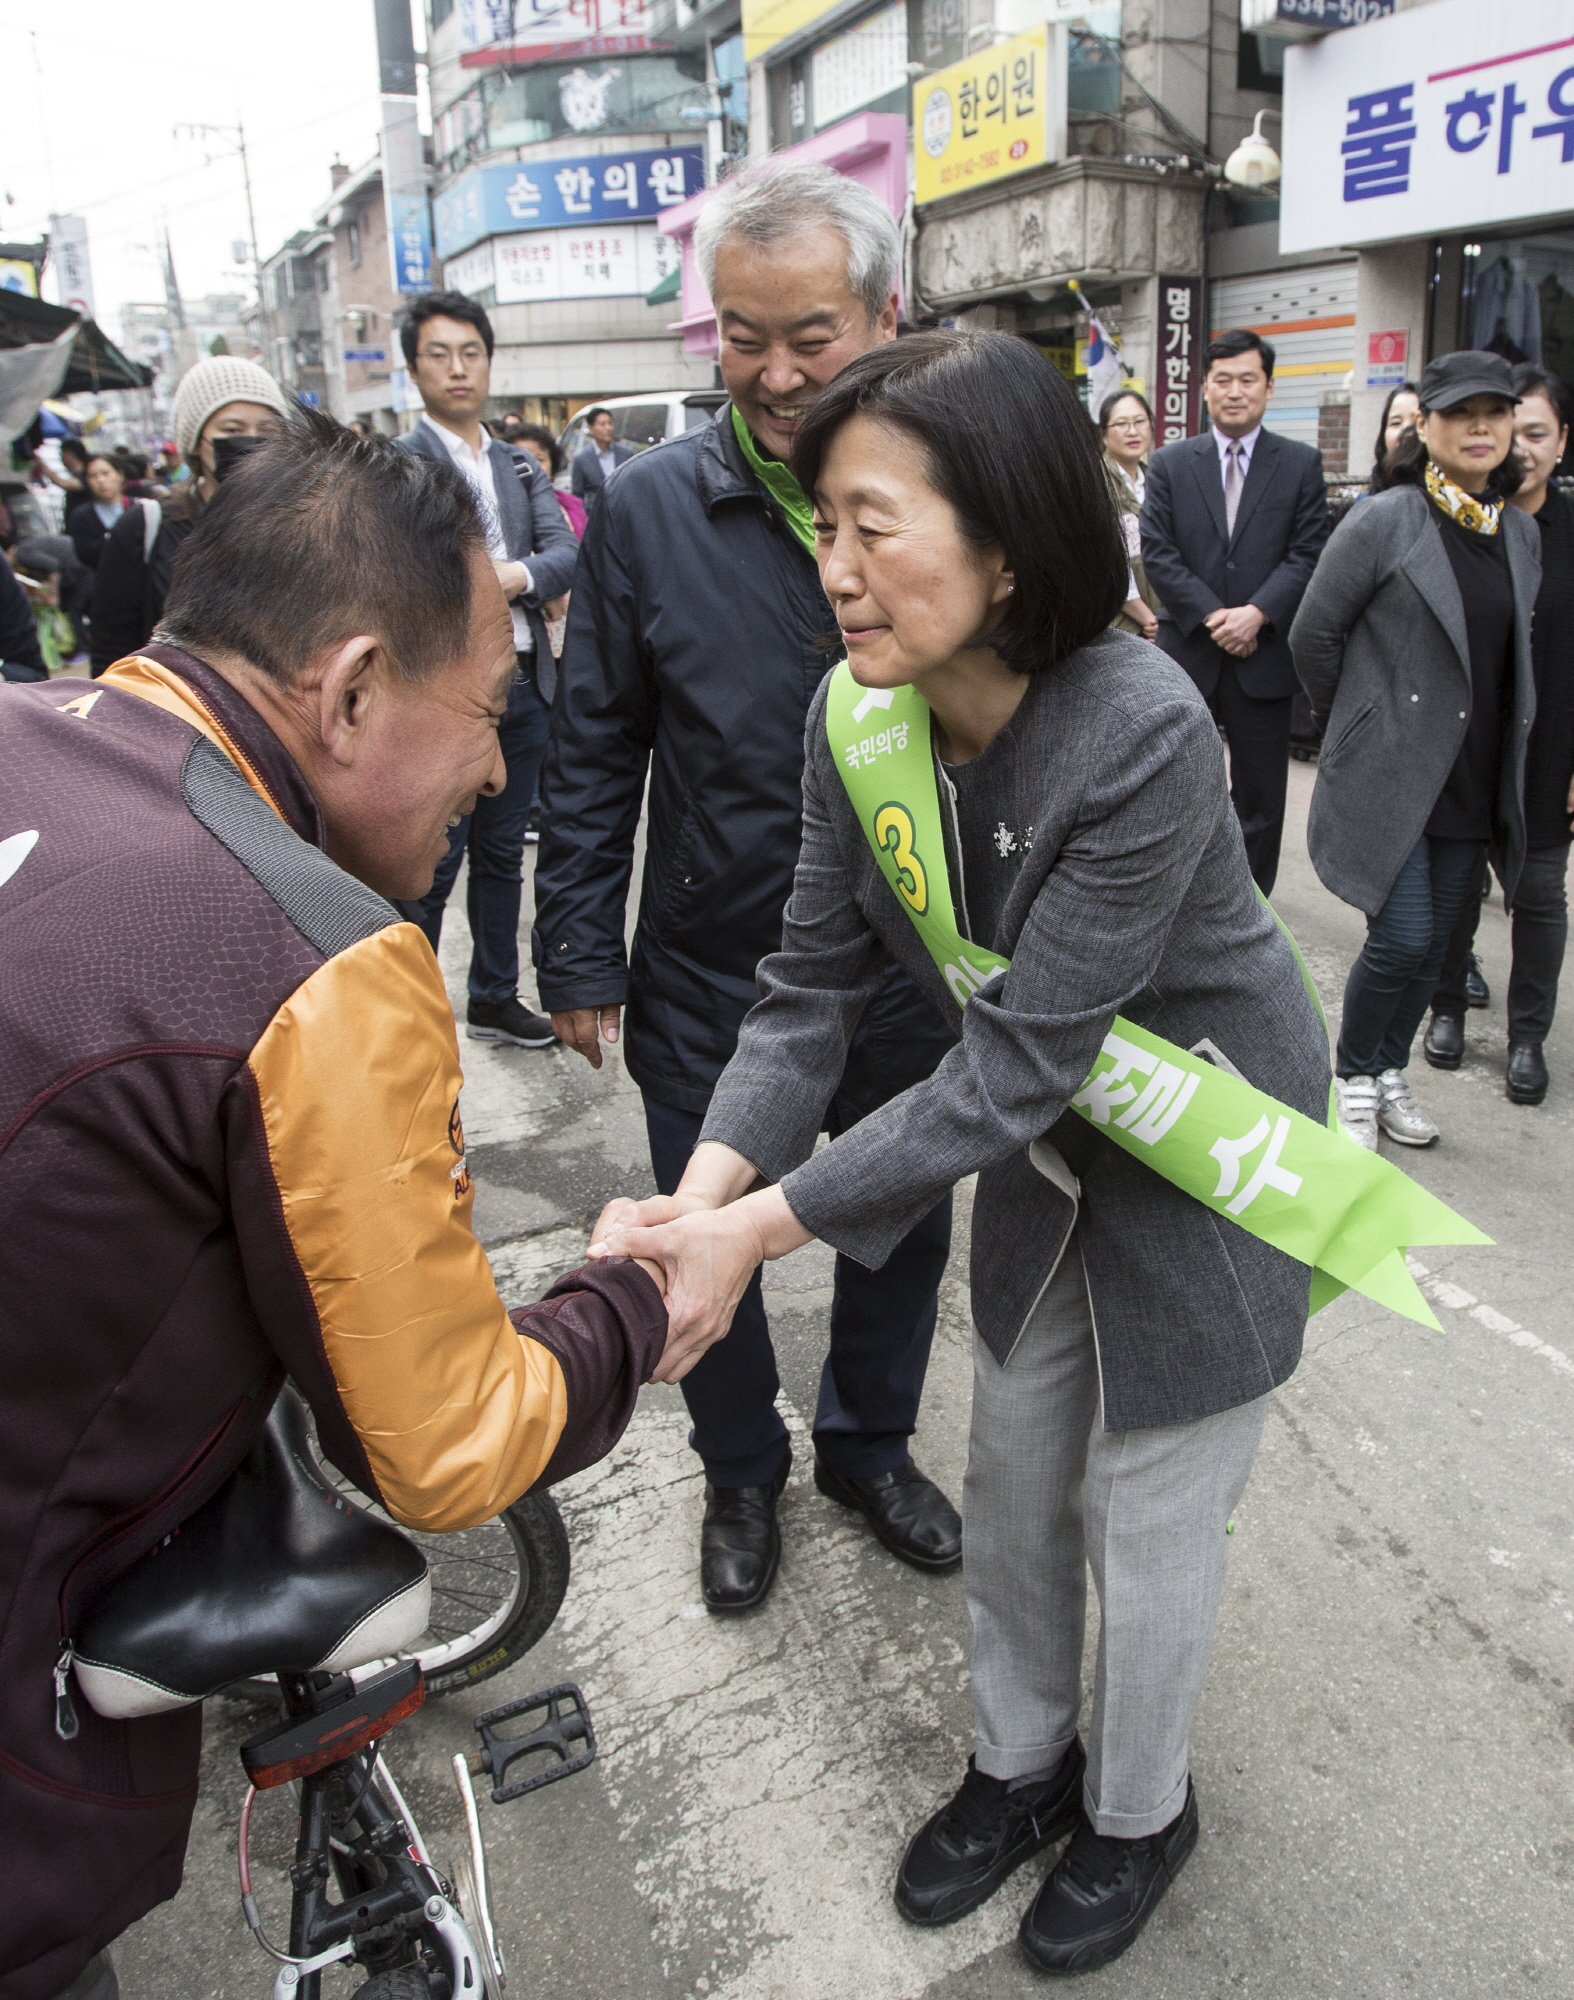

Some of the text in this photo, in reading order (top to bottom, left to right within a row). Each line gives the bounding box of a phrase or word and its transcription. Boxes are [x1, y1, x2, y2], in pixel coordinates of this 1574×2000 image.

[959, 51, 1035, 138] 한의원
[505, 157, 687, 219] 손한의원
[845, 721, 909, 769] 국민의당
[873, 800, 930, 917] 3
